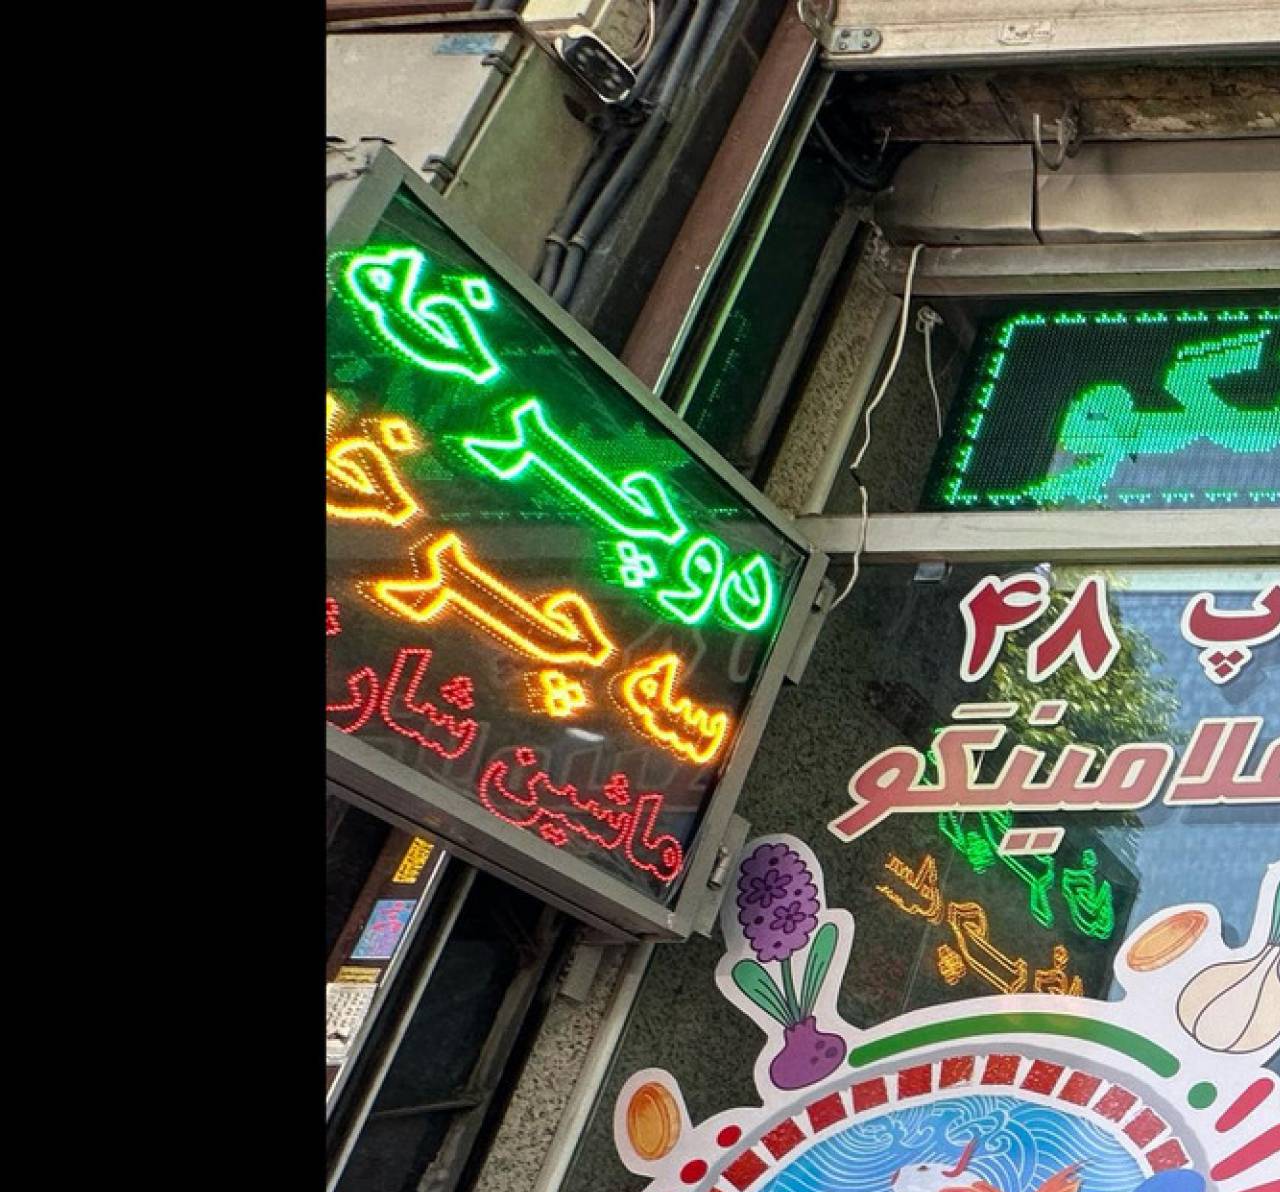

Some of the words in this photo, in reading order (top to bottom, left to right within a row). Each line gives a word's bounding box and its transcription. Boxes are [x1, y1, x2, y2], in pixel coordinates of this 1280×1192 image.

[326, 410, 615, 720] چرخ
[960, 572, 1120, 683] ۴۸
[618, 653, 732, 764] سه
[478, 746, 684, 884] ماشین
